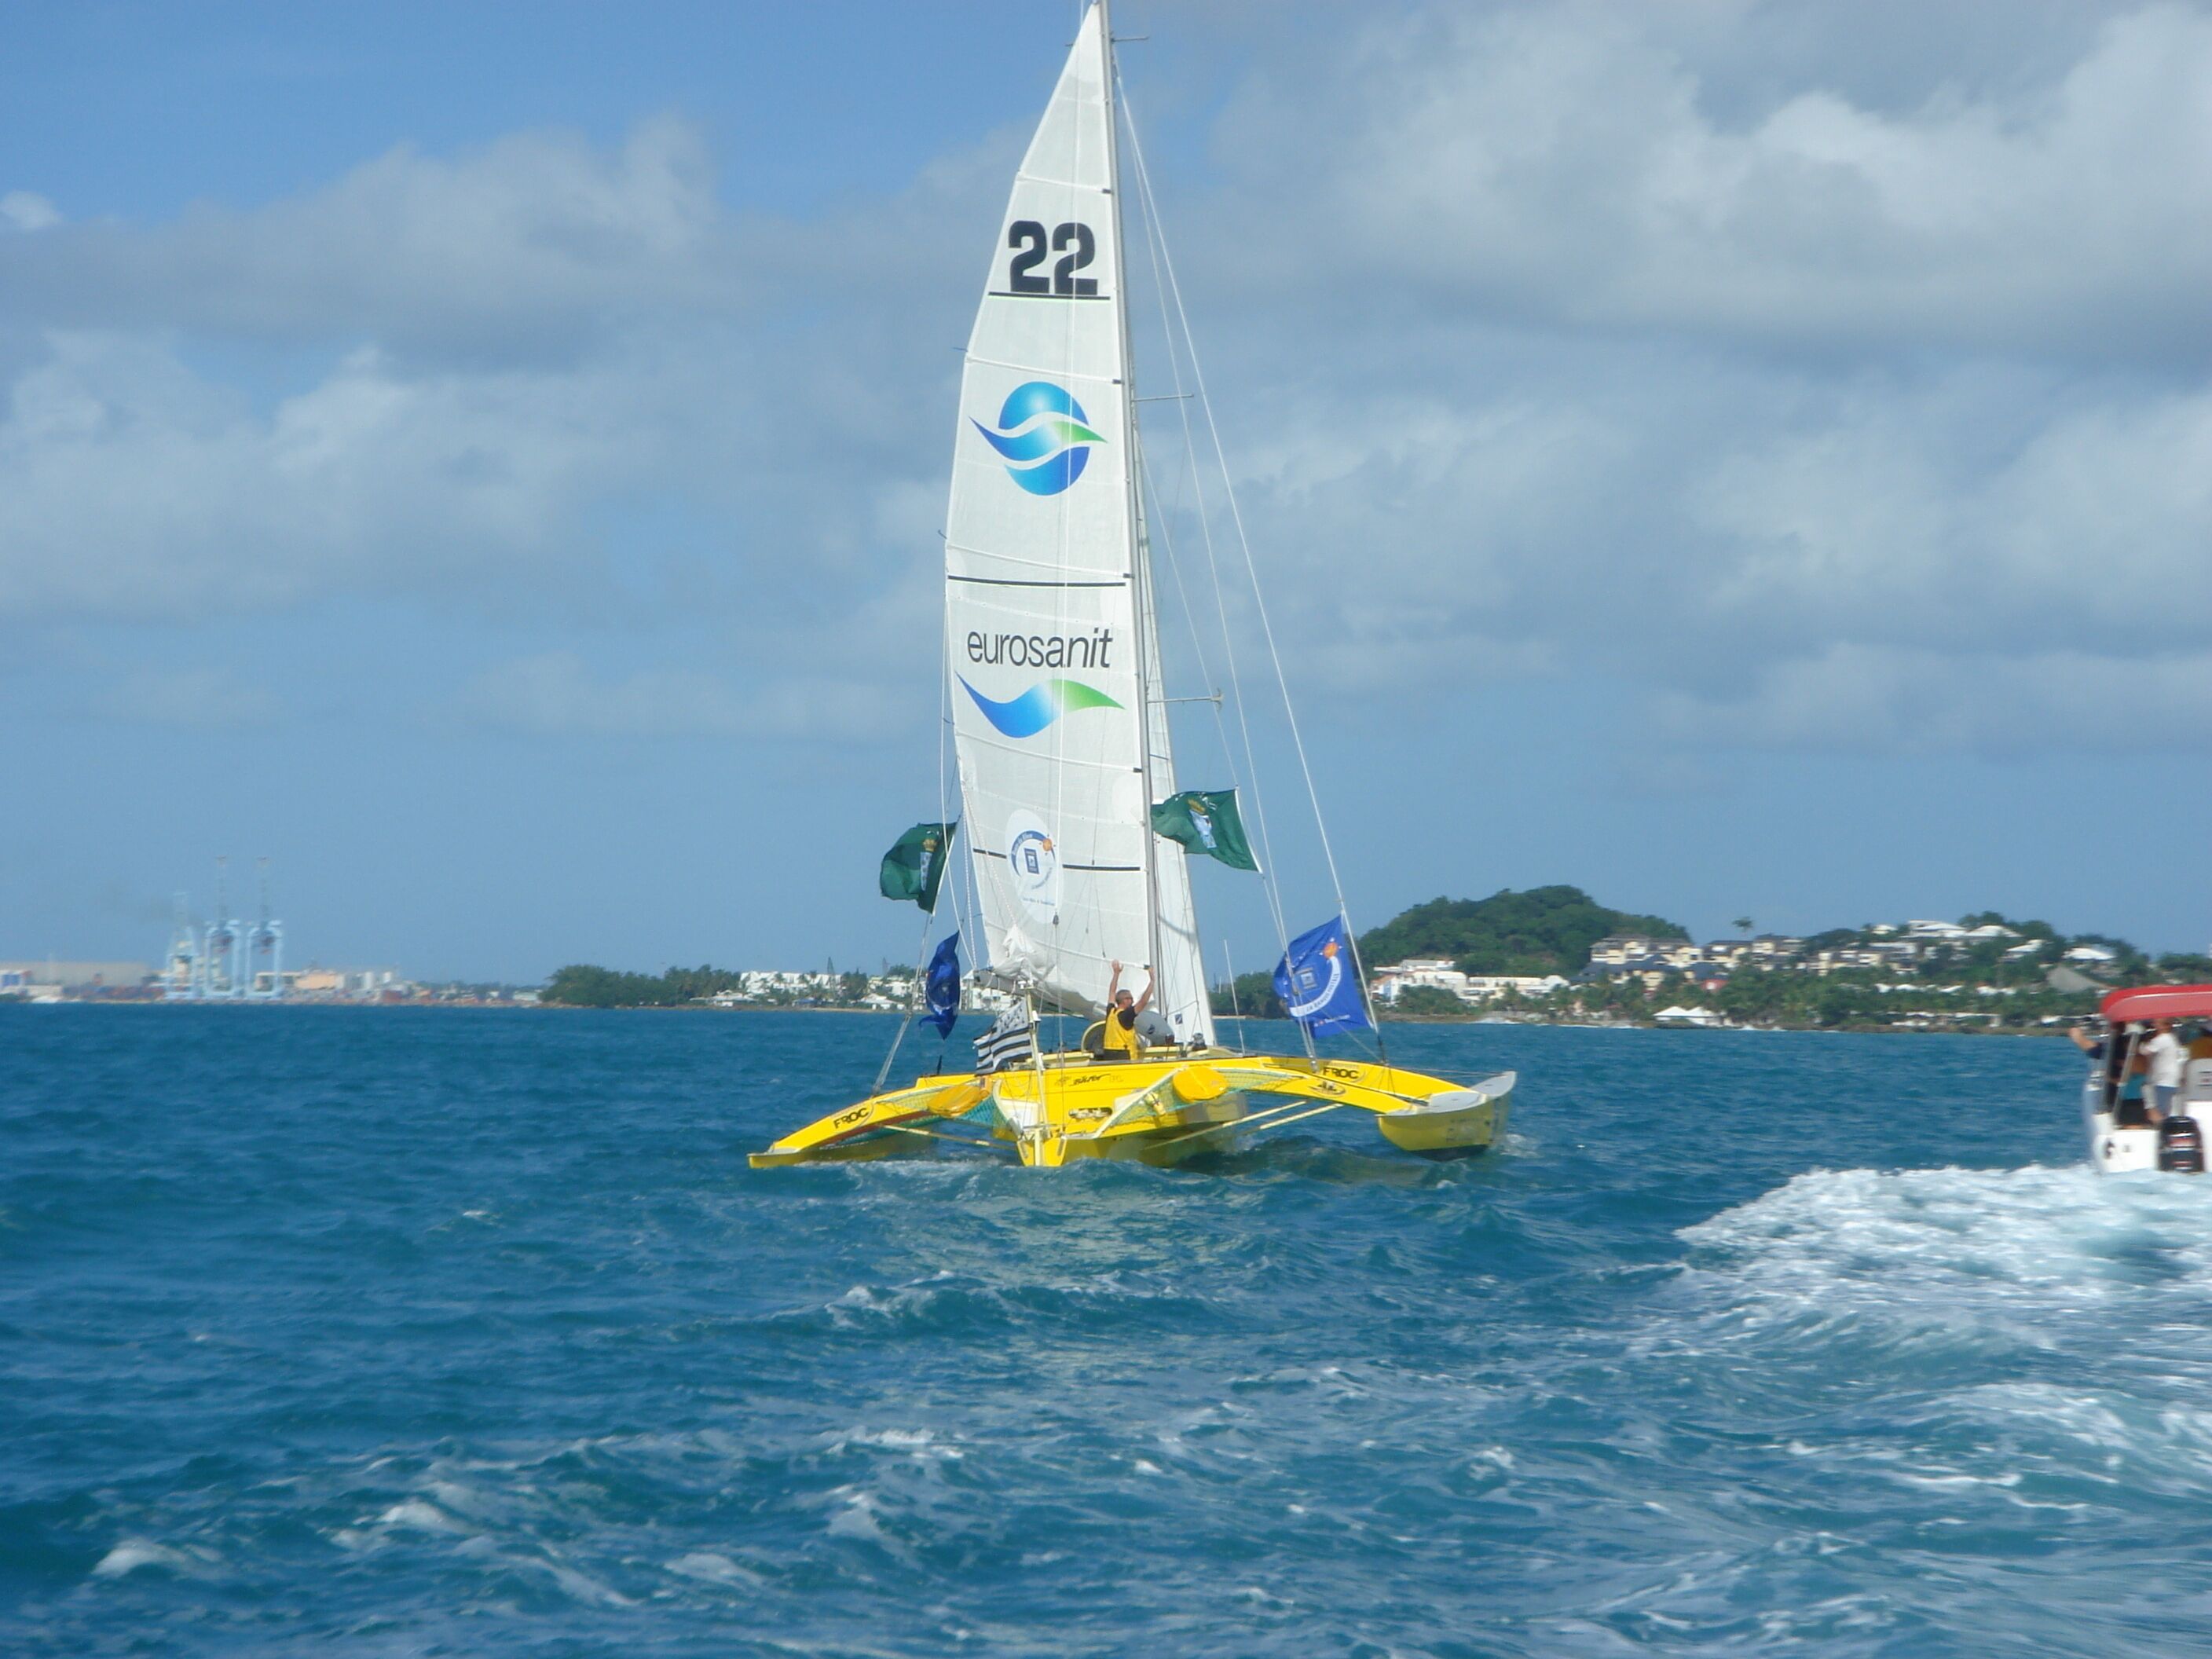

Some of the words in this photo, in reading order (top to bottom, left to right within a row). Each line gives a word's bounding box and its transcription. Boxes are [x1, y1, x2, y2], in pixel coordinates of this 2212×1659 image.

[1008, 220, 1098, 295] 22
[966, 627, 1114, 668] eurosanit
[1323, 1067, 1360, 1079] FROC
[833, 1108, 869, 1129] FROC
